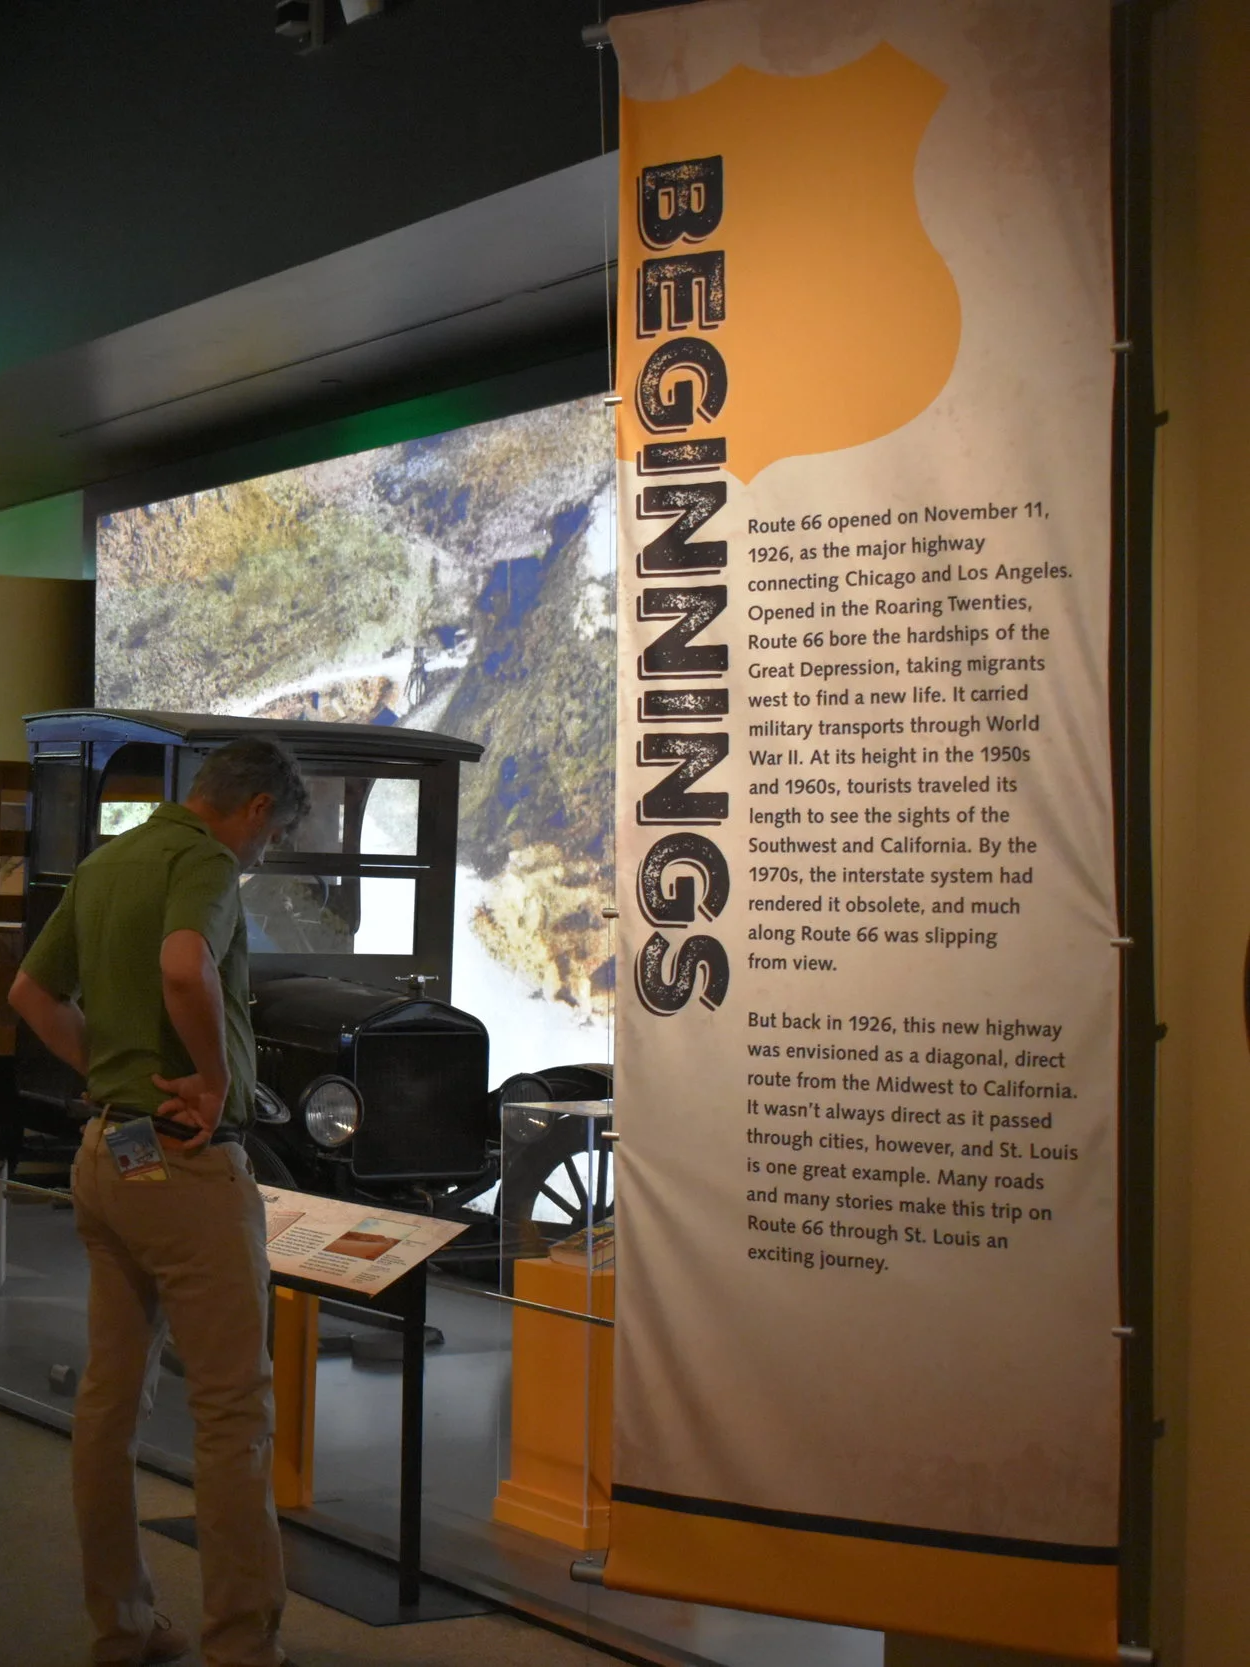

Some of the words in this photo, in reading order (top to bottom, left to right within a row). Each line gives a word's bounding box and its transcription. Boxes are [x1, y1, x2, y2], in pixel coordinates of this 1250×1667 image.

[748, 516, 796, 535] Route
[800, 513, 823, 531] 66
[827, 508, 892, 534] opened
[897, 511, 919, 525] on
[924, 502, 1018, 523] November
[1024, 501, 1050, 520] 11,
[748, 545, 794, 563] 1926,
[799, 547, 818, 561] as
[822, 541, 851, 559] the
[856, 539, 907, 561] major
[911, 534, 986, 558] highway
[635, 154, 730, 1017] BEGINNINGS
[747, 573, 840, 593] connecting
[845, 569, 916, 590] Chicago
[921, 564, 952, 584] and
[958, 564, 989, 581] Los
[994, 561, 1073, 585] Angeles.
[747, 601, 815, 625] Opened
[820, 602, 836, 618] in
[841, 599, 869, 617] the
[875, 597, 943, 618] Roaring
[947, 594, 1033, 613] Twenties,
[748, 633, 798, 650] Route
[802, 631, 824, 648] 66
[829, 629, 867, 647] bore
[872, 627, 901, 645] the
[907, 624, 989, 647] hardships
[995, 623, 1016, 641] of
[1020, 622, 1050, 641] the
[748, 662, 795, 679] Great
[800, 661, 900, 682] Depression,
[906, 656, 962, 677] taking
[966, 655, 1046, 676] migrants
[747, 691, 788, 708] west
[792, 691, 811, 707] to
[815, 688, 849, 706] find
[854, 692, 865, 705] a
[870, 691, 907, 705] new
[913, 685, 946, 704] life.
[953, 686, 966, 703] It
[970, 683, 1029, 702] carried
[749, 719, 813, 741] military
[818, 718, 905, 740] transports
[909, 714, 981, 738] through
[985, 713, 1040, 732] World
[748, 749, 783, 766] War
[788, 749, 805, 765] II.
[809, 749, 830, 765] At
[835, 748, 856, 765] its
[861, 746, 917, 769] height
[922, 747, 939, 763] in
[945, 745, 974, 763] the
[980, 745, 1031, 763] 1950s
[748, 777, 779, 795] and
[784, 778, 841, 797] 1960s,
[846, 777, 912, 794] tourists
[917, 775, 990, 794] traveled
[996, 776, 1018, 793] its
[749, 806, 802, 829] length
[806, 808, 825, 824] to
[830, 811, 859, 824] see
[863, 806, 892, 824] the
[897, 806, 951, 829] sights
[956, 805, 976, 824] of
[980, 805, 1010, 824] the
[748, 836, 837, 854] Southwest
[841, 836, 874, 854] and
[880, 835, 972, 854] California.
[979, 837, 1002, 859] By
[1007, 835, 1037, 854] the
[748, 866, 804, 885] 1970s,
[809, 865, 837, 883] the
[842, 867, 925, 884] interstate
[930, 867, 993, 889] system
[999, 866, 1033, 884] had
[748, 894, 822, 912] rendered
[828, 896, 841, 913] it
[845, 895, 925, 916] obsolete,
[931, 896, 965, 914] and
[971, 896, 1020, 915] much
[748, 923, 796, 946] along
[801, 925, 851, 942] Route
[856, 926, 879, 943] 66
[883, 930, 919, 944] was
[924, 926, 998, 950] slipping
[747, 952, 787, 970] from
[792, 954, 837, 972] view.
[748, 1011, 777, 1029] But
[782, 1011, 821, 1030] back
[826, 1013, 842, 1031] in
[848, 1015, 897, 1035] 1926,
[902, 1015, 936, 1034] this
[942, 1022, 980, 1035] new
[986, 1017, 1063, 1043] highway
[747, 1044, 781, 1058] was
[785, 1043, 879, 1062] envisioned
[884, 1050, 904, 1063] as
[909, 1050, 920, 1064] a
[925, 1046, 1008, 1070] diagonal,
[1014, 1049, 1066, 1069] direct
[747, 1071, 791, 1088] route
[796, 1071, 836, 1090] from
[841, 1073, 870, 1092] the
[875, 1075, 954, 1095] Midwest
[959, 1079, 978, 1096] to
[983, 1079, 1078, 1099] California.
[747, 1098, 759, 1115] It
[763, 1102, 821, 1119] wasn't
[825, 1102, 886, 1126] always
[890, 1105, 941, 1125] direct
[946, 1112, 966, 1126] as
[972, 1109, 985, 1127] it
[989, 1111, 1053, 1132] passed
[746, 1127, 813, 1152] through
[818, 1132, 869, 1153] cities,
[875, 1134, 955, 1158] however,
[960, 1139, 994, 1158] and
[999, 1141, 1023, 1159] St.
[1030, 1142, 1079, 1161] Louis
[747, 1156, 761, 1173] is
[765, 1161, 798, 1176] one
[802, 1163, 847, 1182] great
[851, 1166, 931, 1188] example.
[937, 1168, 988, 1193] Many
[994, 1172, 1045, 1190] roads
[746, 1186, 778, 1204] and
[783, 1192, 831, 1212] many
[836, 1193, 894, 1212] stories
[899, 1197, 947, 1215] make
[951, 1199, 986, 1218] this
[990, 1202, 1023, 1225] trip
[1028, 1207, 1052, 1221] on
[747, 1214, 797, 1234] Route
[801, 1219, 824, 1236] 66
[829, 1220, 899, 1246] through
[904, 1226, 927, 1244] St.
[933, 1228, 981, 1248] Louis
[986, 1235, 1008, 1249] an
[747, 1246, 815, 1270] exciting
[818, 1246, 889, 1275] journey.
